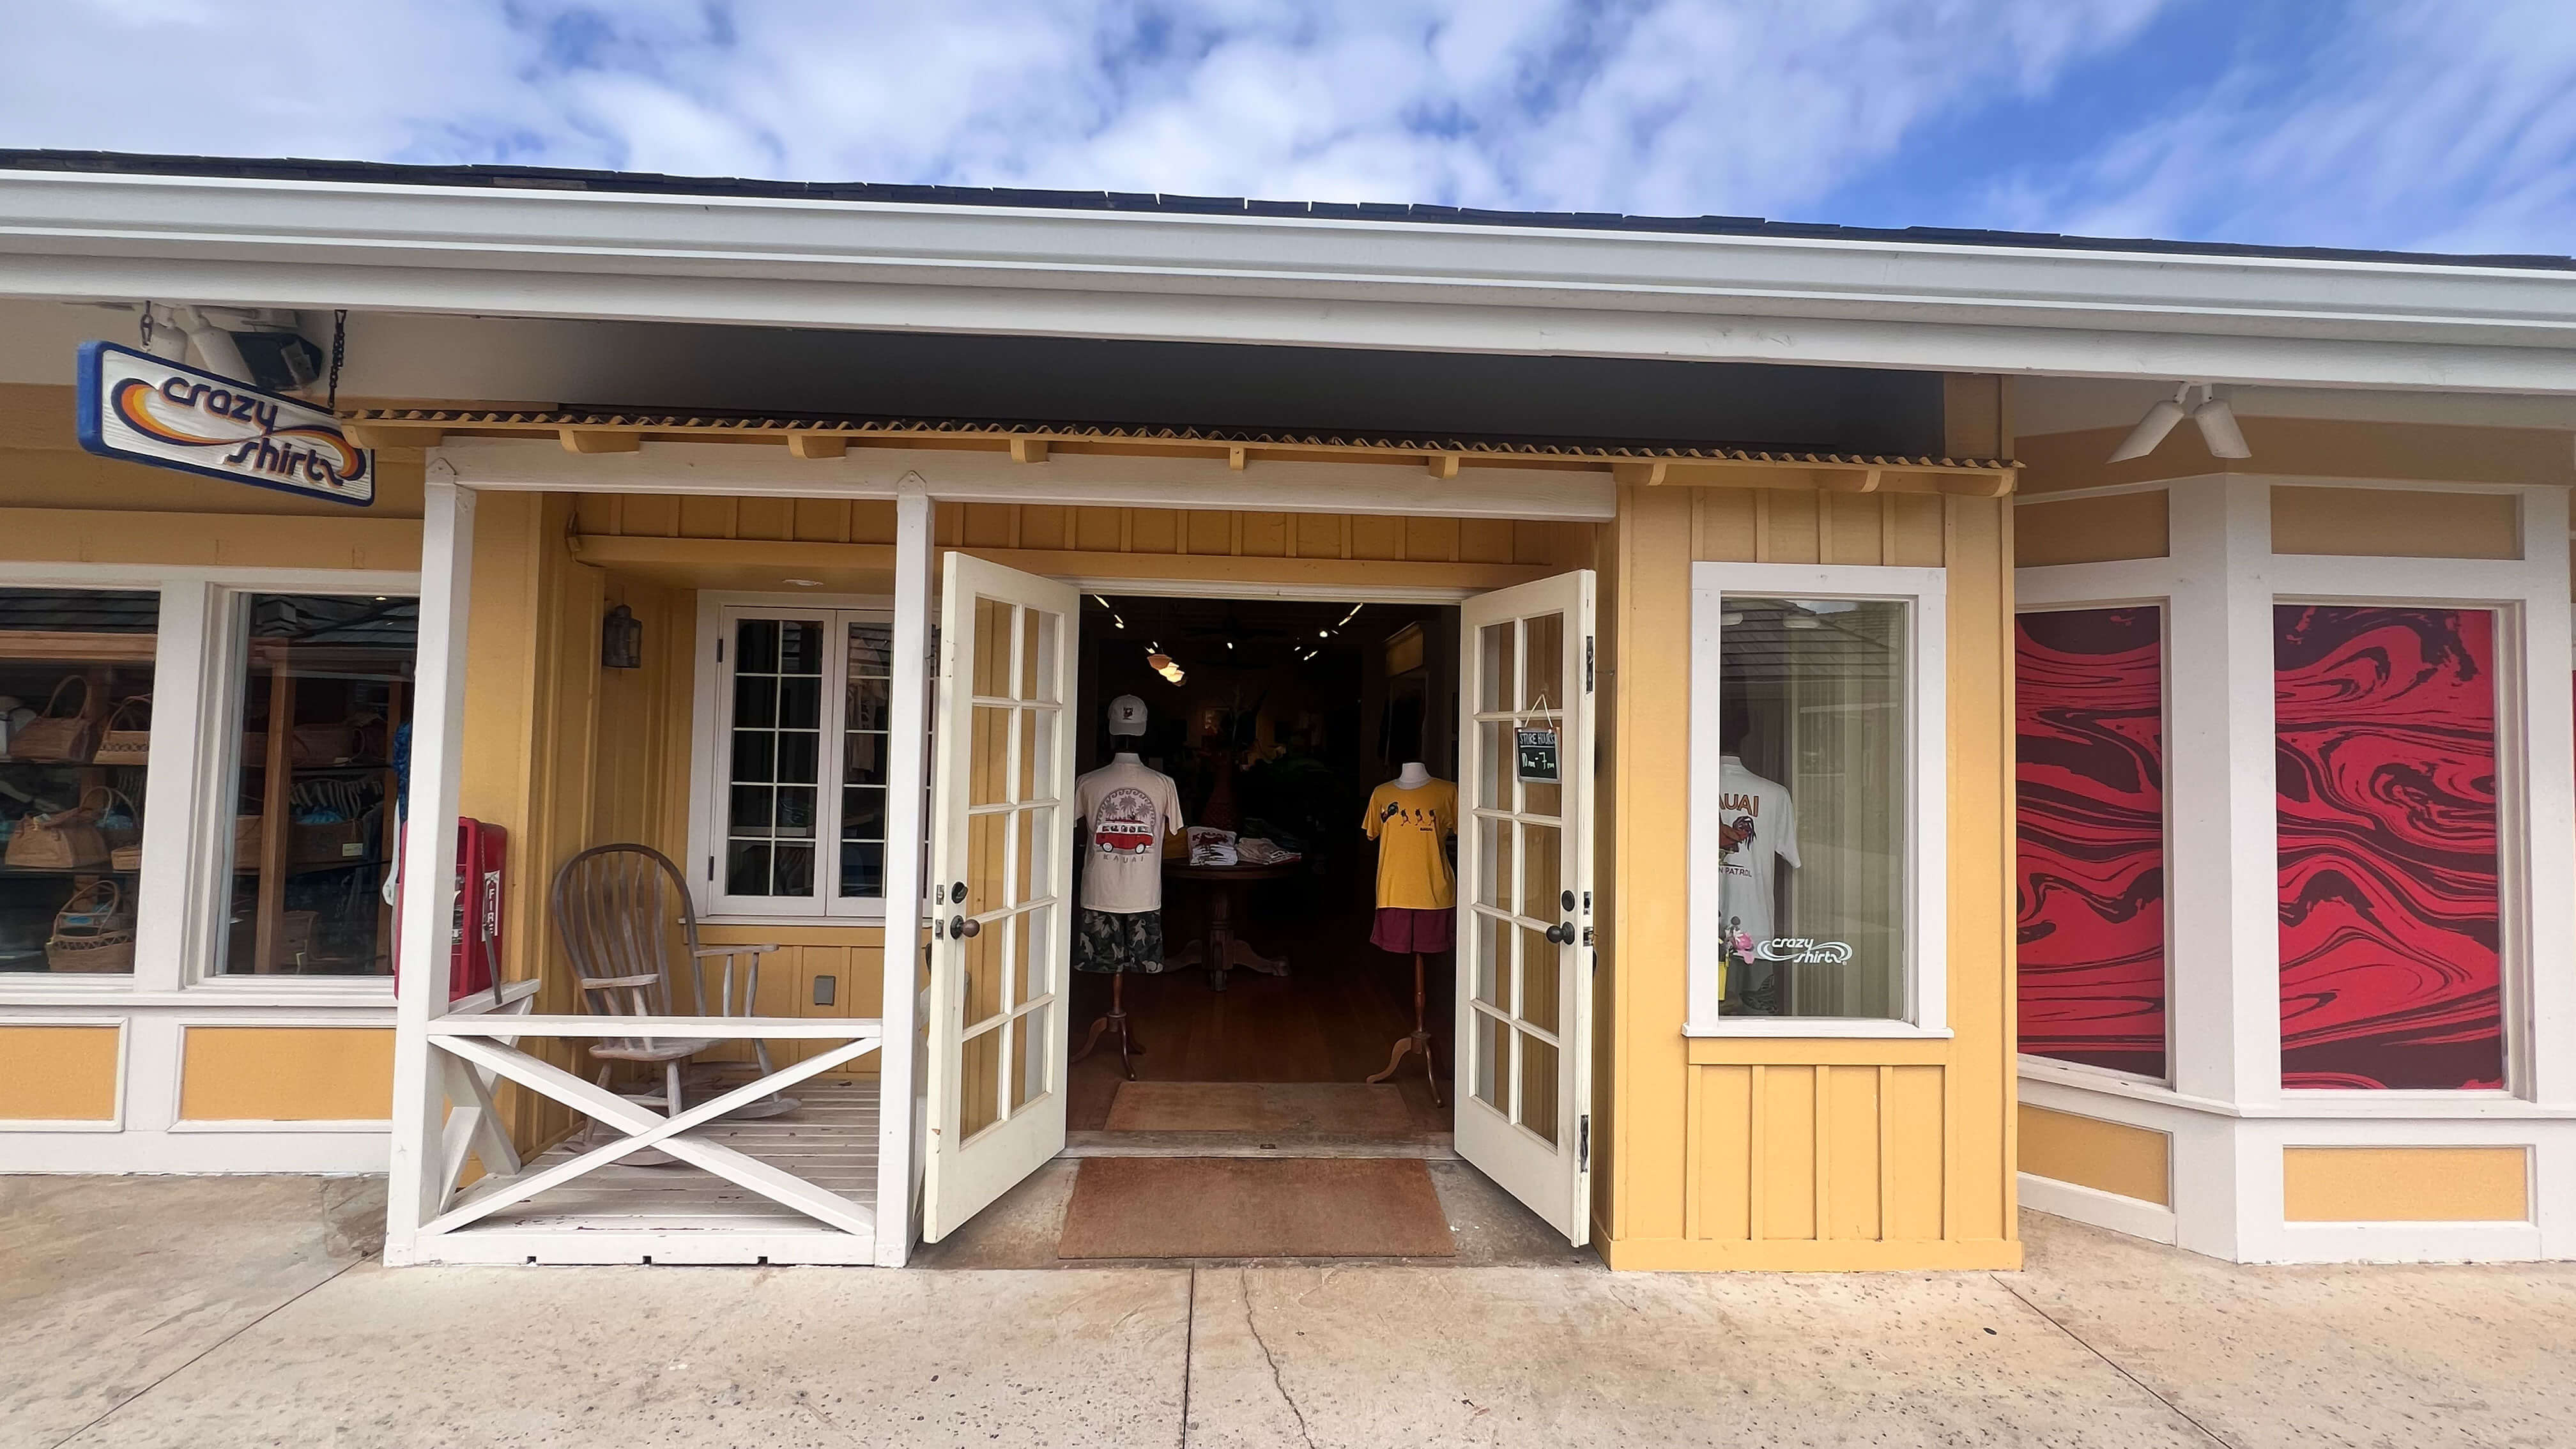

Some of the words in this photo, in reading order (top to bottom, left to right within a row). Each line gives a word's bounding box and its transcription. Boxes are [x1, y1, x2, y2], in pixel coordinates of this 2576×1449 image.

[160, 377, 277, 436] crazy
[1719, 793, 1759, 817] UAI
[1103, 854, 1144, 863] KAUAI
[1725, 868, 1752, 877] PATROL
[1772, 937, 1814, 950] crazy
